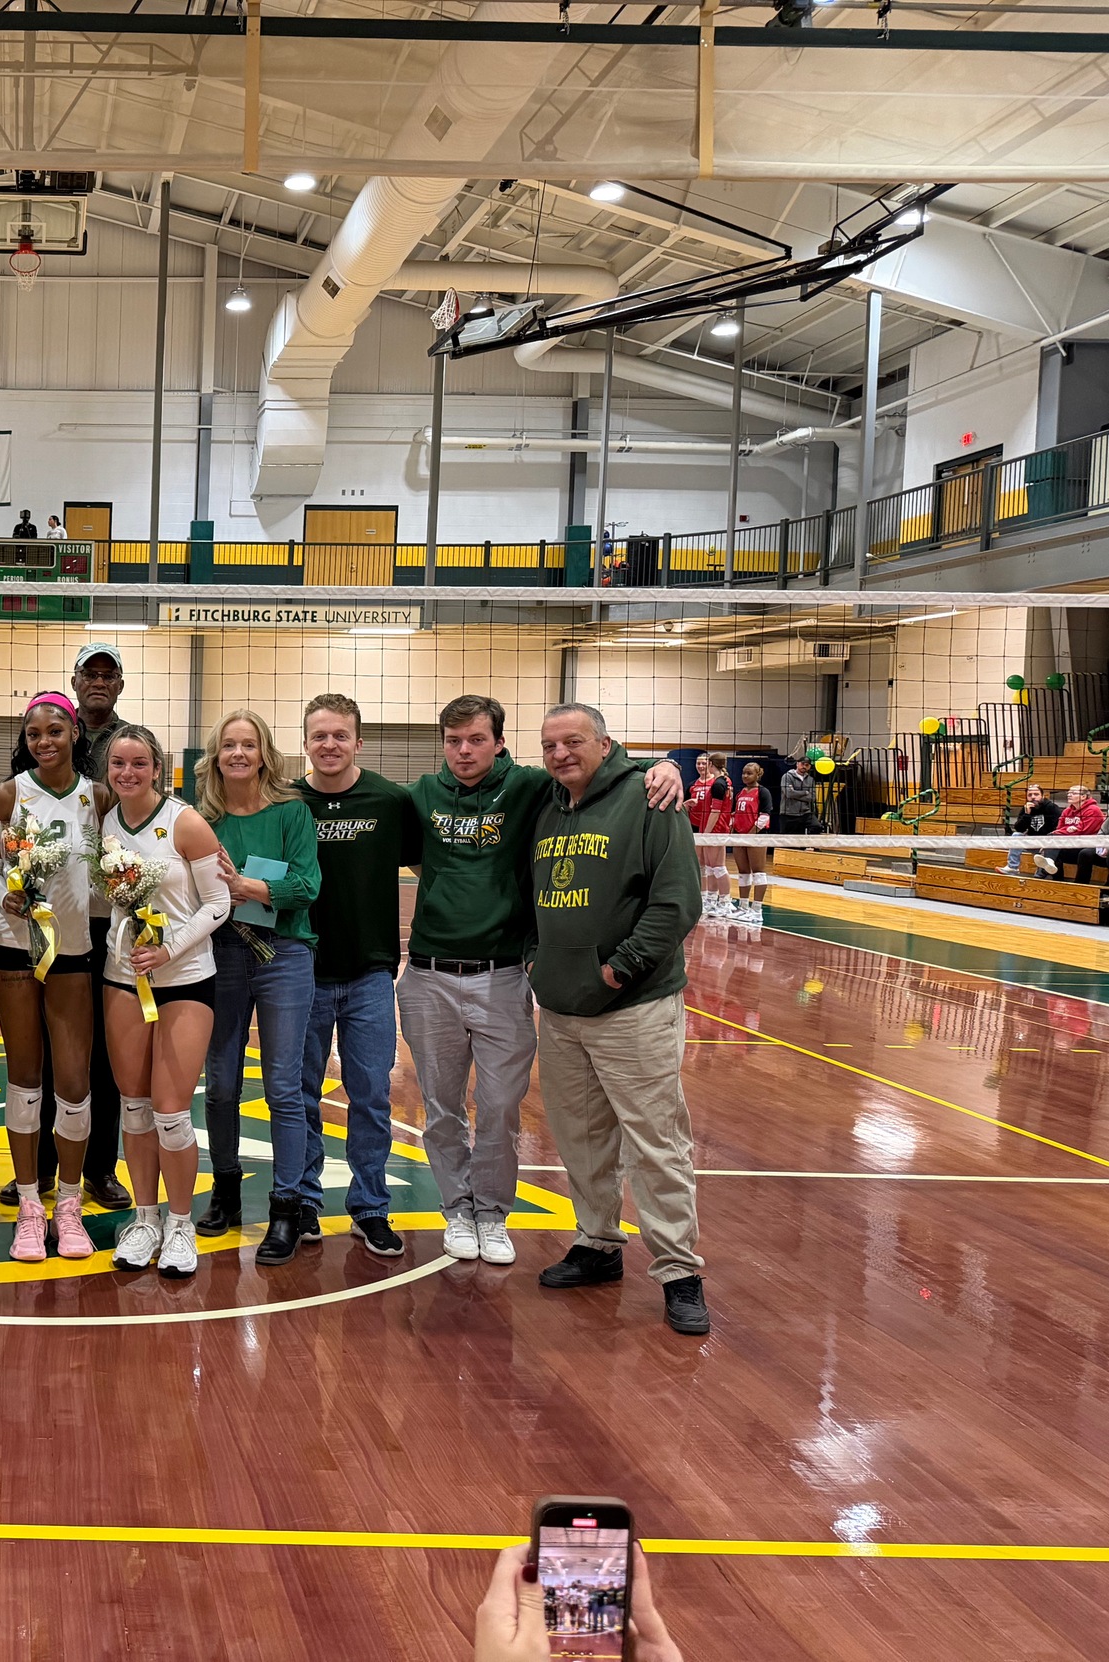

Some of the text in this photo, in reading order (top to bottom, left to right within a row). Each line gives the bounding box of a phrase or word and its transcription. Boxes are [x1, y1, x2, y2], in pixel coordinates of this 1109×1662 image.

[58, 544, 91, 554] VISITOR
[189, 608, 411, 624] FITCHBURG STATE UNIVERSITY
[315, 820, 375, 831] TCHBURG
[317, 829, 355, 839] STATE
[577, 832, 610, 859] STATE
[537, 887, 590, 908] ALUMNI
